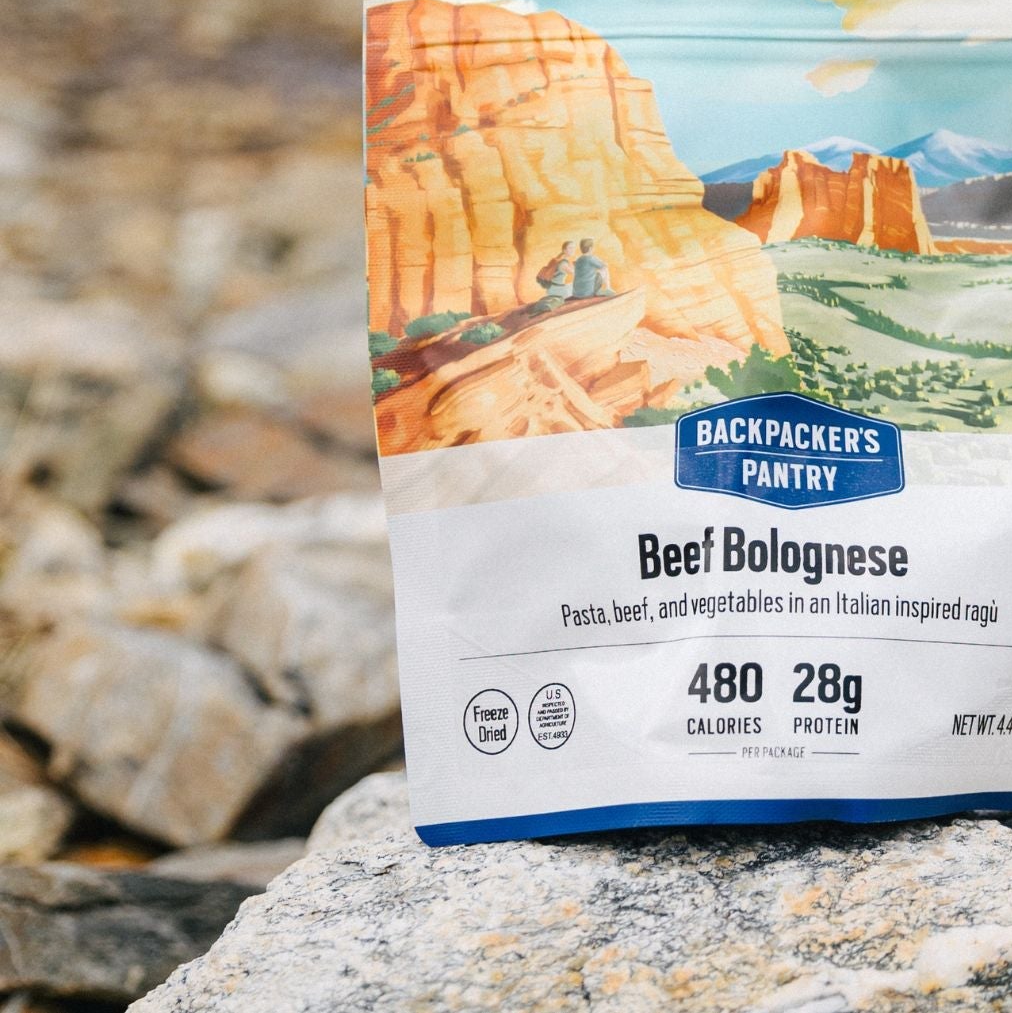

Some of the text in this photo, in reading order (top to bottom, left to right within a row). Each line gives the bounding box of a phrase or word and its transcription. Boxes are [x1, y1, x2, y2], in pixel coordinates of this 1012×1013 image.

[696, 417, 881, 454] BACKPACKER'S
[742, 458, 838, 492] PANTRY
[638, 526, 909, 585] Beef Bolognese
[561, 589, 999, 628] Pasta, beef, and vegetables in an Italian inspired ragù
[687, 662, 863, 714] 480 28g
[473, 705, 509, 723] Freeze
[687, 716, 859, 736] CALORIES PROTEIN
[952, 713, 977, 736] NET
[977, 713, 996, 736] WT.
[478, 724, 507, 743] Dried
[742, 746, 806, 759] PER PACKAGE
